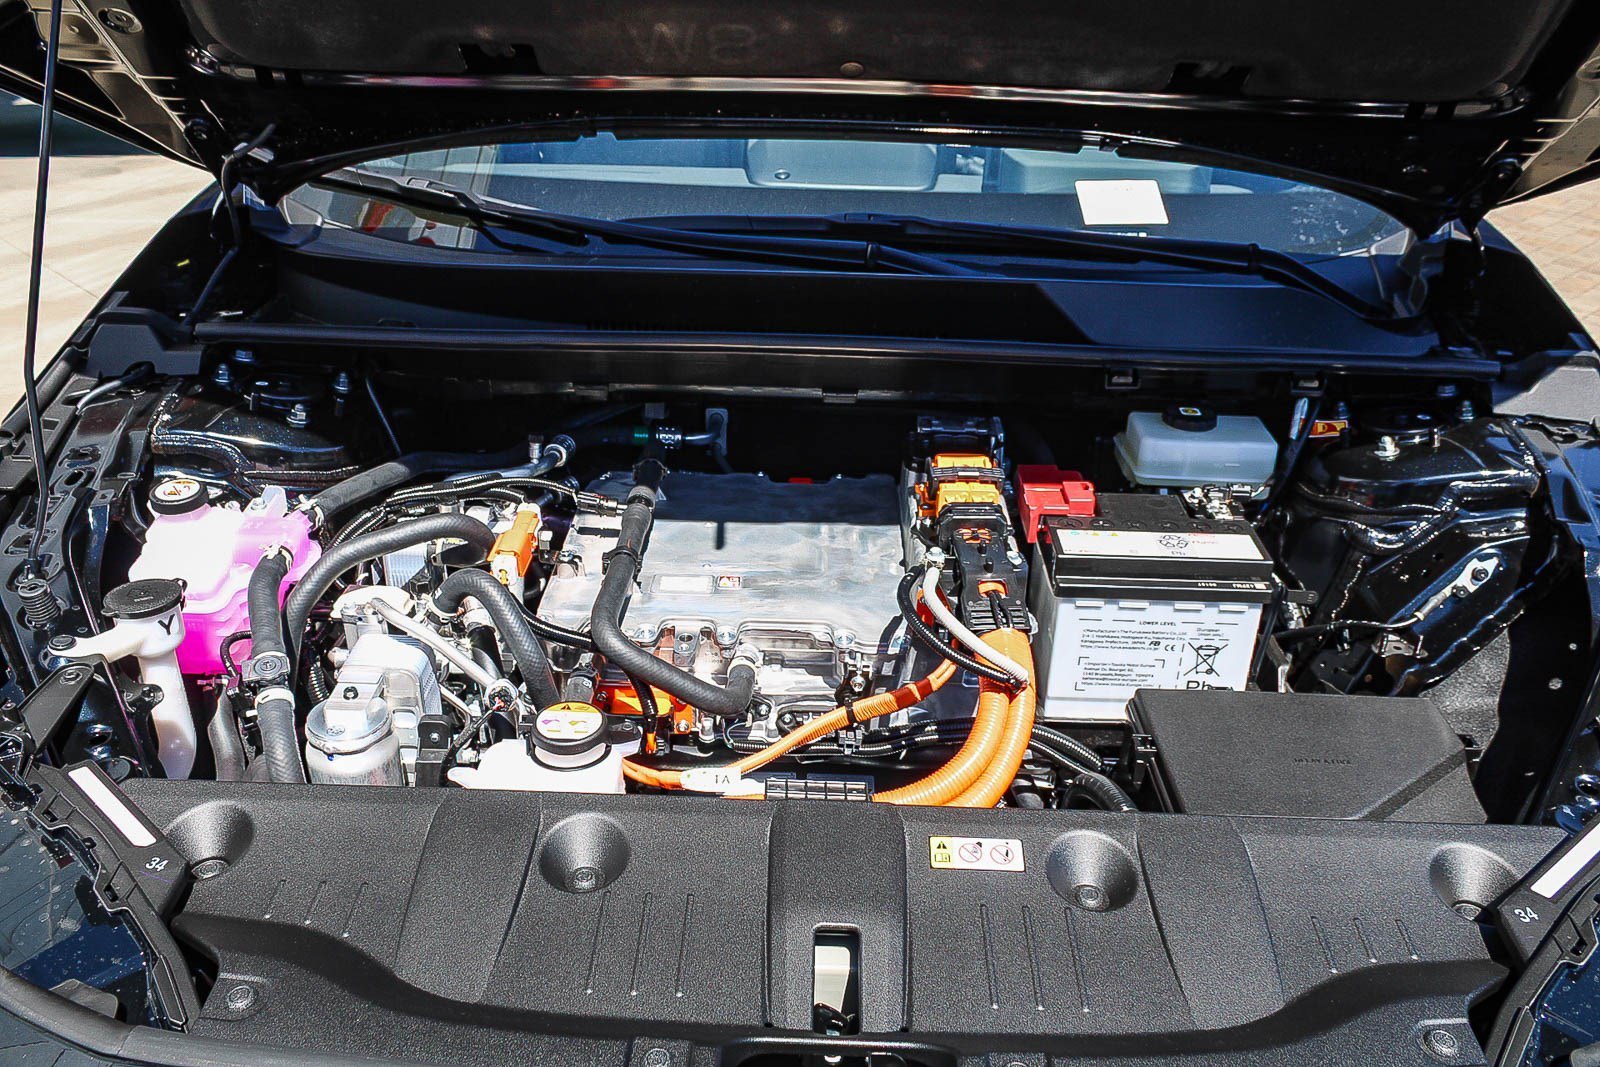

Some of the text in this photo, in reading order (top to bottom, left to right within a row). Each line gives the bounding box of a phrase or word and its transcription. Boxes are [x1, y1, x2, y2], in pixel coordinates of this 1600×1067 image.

[157, 613, 176, 636] Y
[145, 856, 169, 872] 34
[1514, 906, 1539, 923] 34
